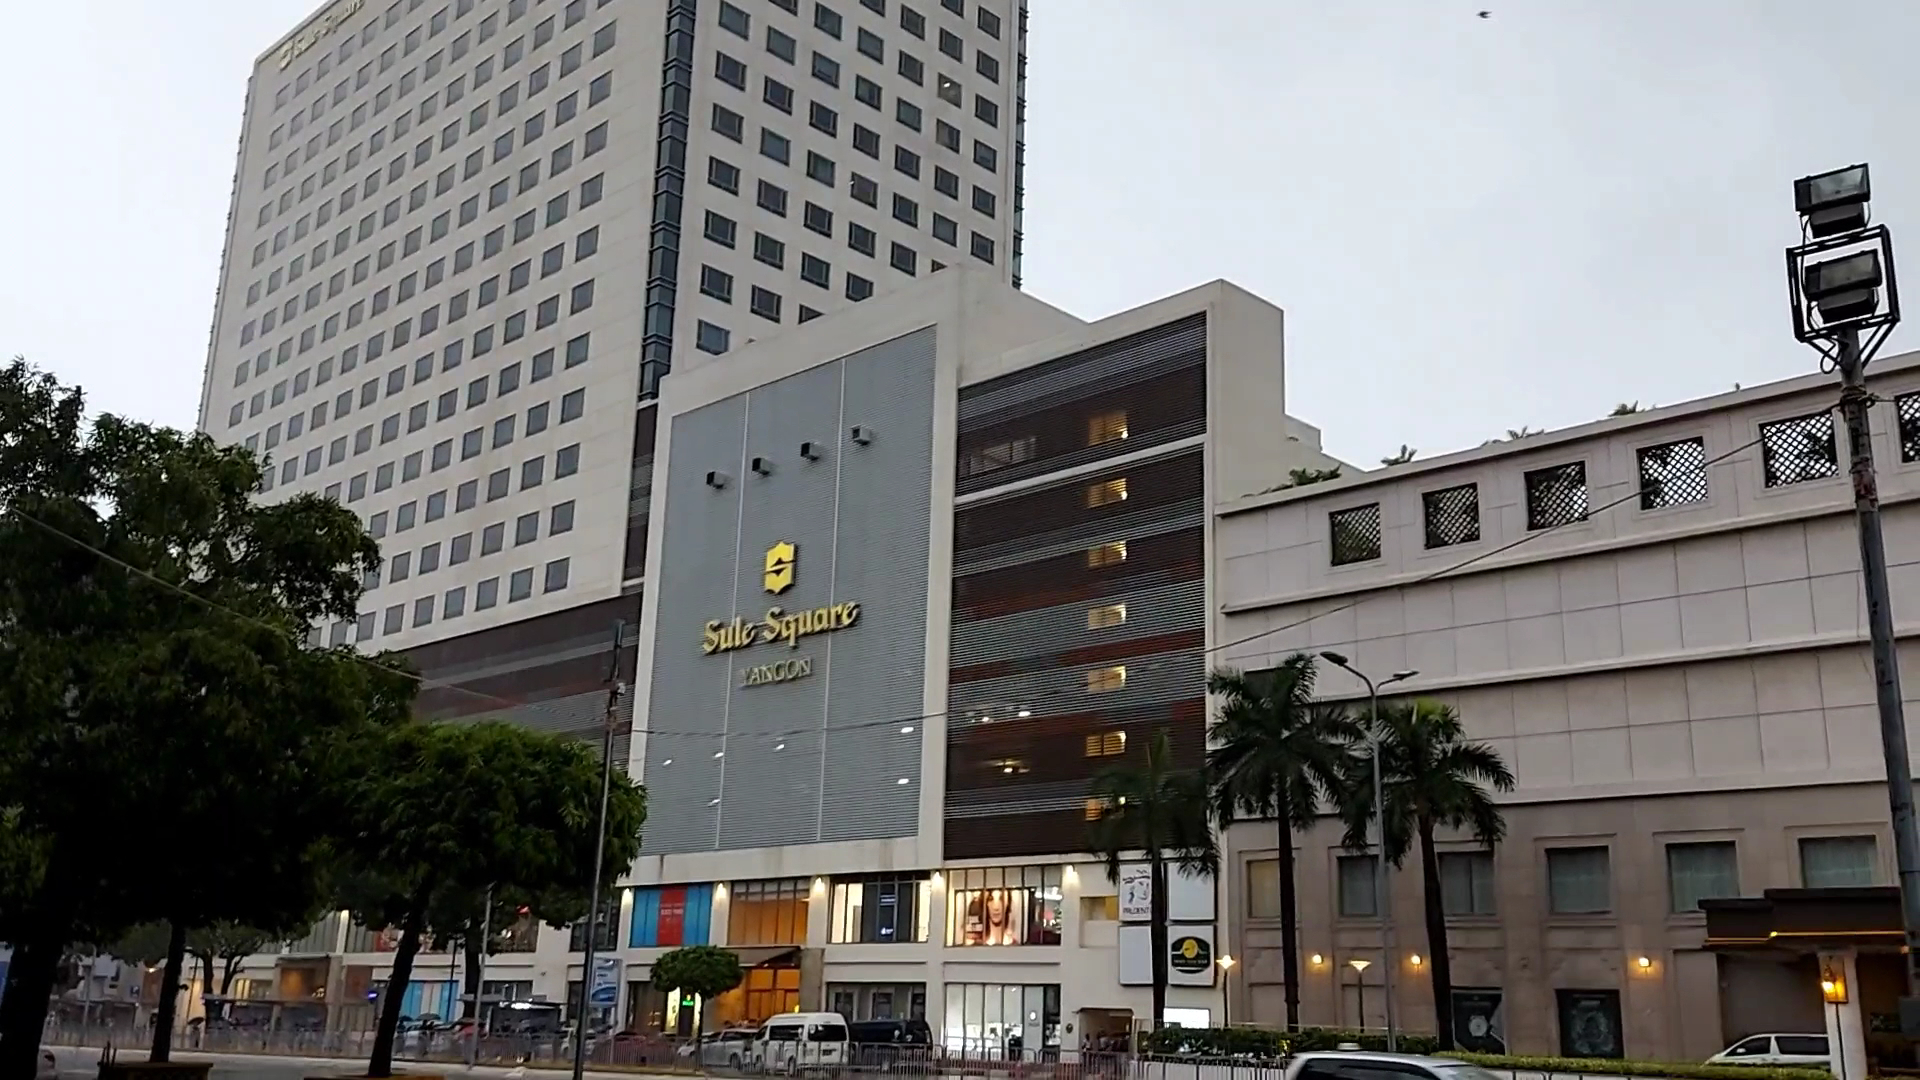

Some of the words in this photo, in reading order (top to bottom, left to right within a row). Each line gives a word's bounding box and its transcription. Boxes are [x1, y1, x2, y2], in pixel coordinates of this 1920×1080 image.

[702, 615, 756, 653] Sule
[763, 601, 858, 647] Square
[740, 656, 812, 686] YANGON
[1123, 906, 1149, 915] PRUDENT
